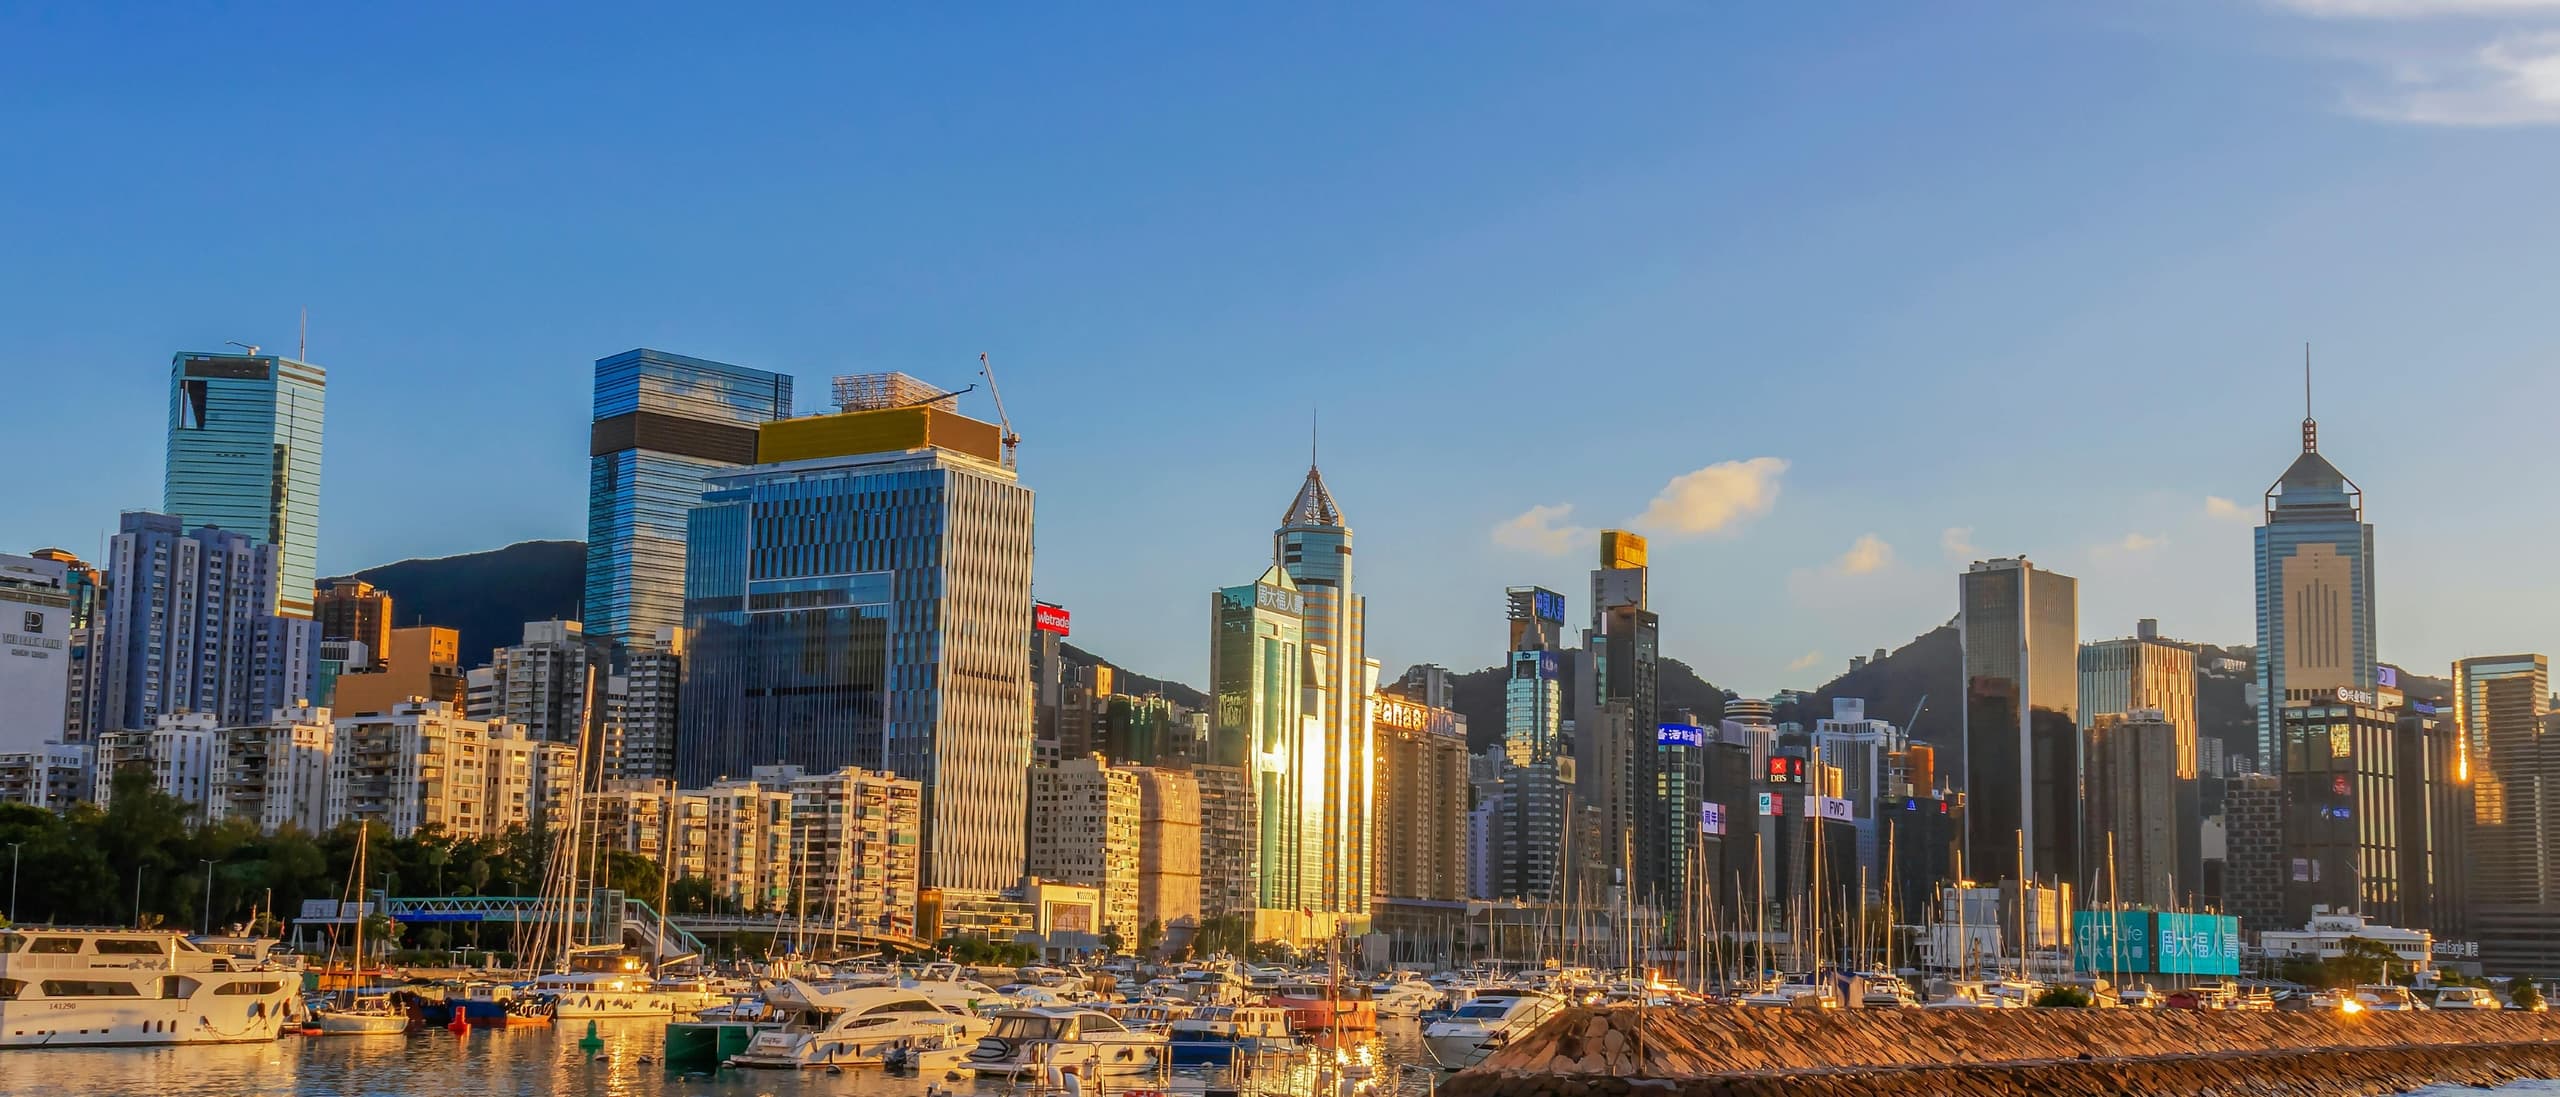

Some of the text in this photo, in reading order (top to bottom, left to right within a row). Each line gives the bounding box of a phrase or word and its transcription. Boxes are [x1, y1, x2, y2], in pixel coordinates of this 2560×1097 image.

[1373, 692, 1454, 736] Panasonic
[1770, 774, 1787, 782] DBS
[1829, 800, 1845, 816] FWD
